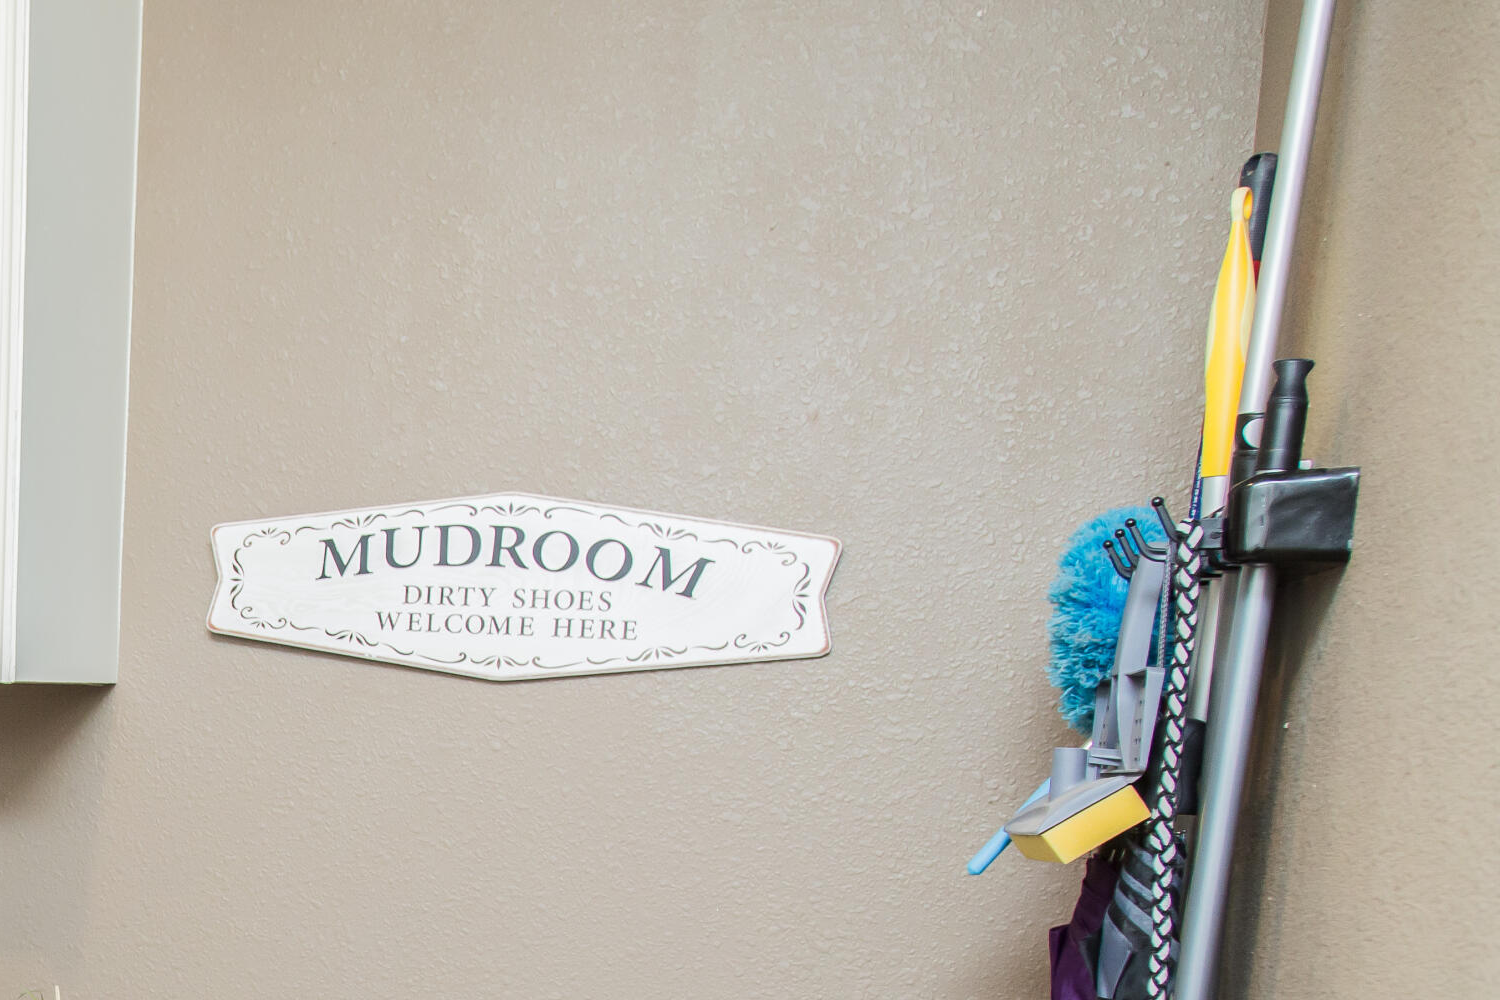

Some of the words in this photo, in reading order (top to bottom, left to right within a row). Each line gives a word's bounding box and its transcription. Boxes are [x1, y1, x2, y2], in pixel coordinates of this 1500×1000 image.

[315, 523, 715, 600] MUDROOM
[402, 584, 497, 607] DIRTY
[513, 588, 613, 612] SHOES
[375, 610, 535, 638] WELCOME
[552, 617, 638, 641] HERE
